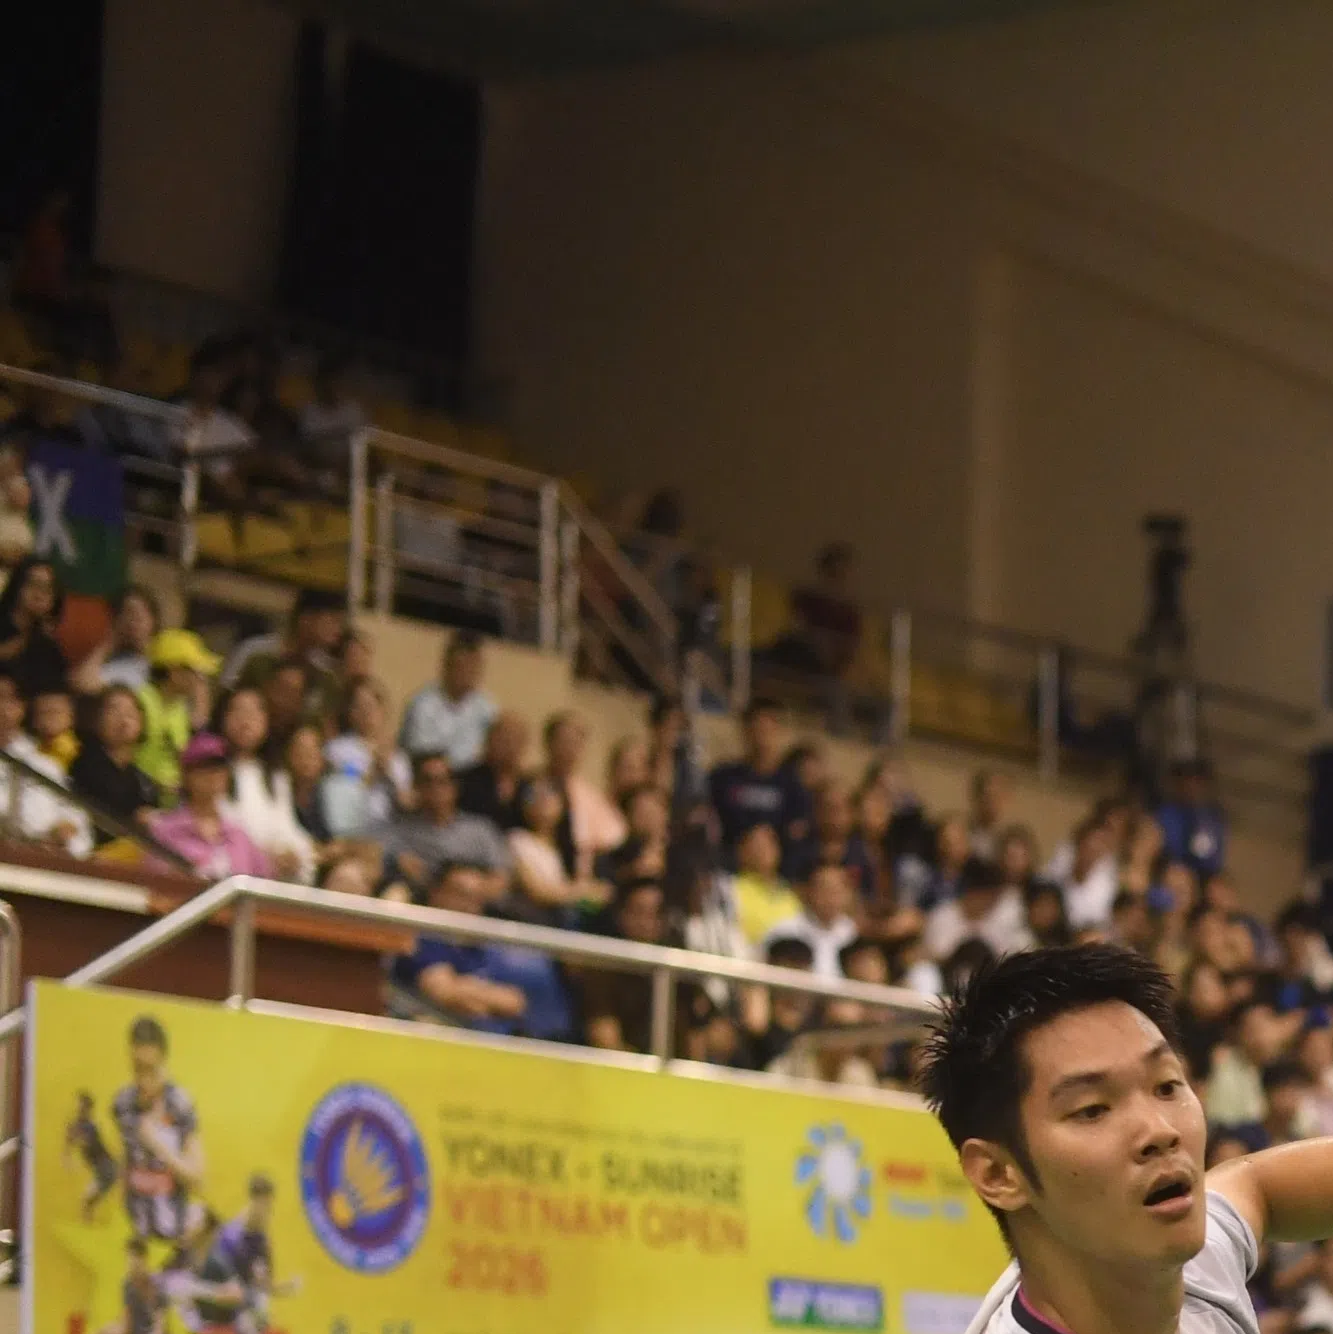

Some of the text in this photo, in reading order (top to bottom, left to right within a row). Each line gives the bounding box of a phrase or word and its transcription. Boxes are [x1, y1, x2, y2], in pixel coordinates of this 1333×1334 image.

[445, 1135, 567, 1182] YONEX
[601, 1153, 743, 1202] SUNRISE
[443, 1183, 748, 1253] VIETNAM OPEN
